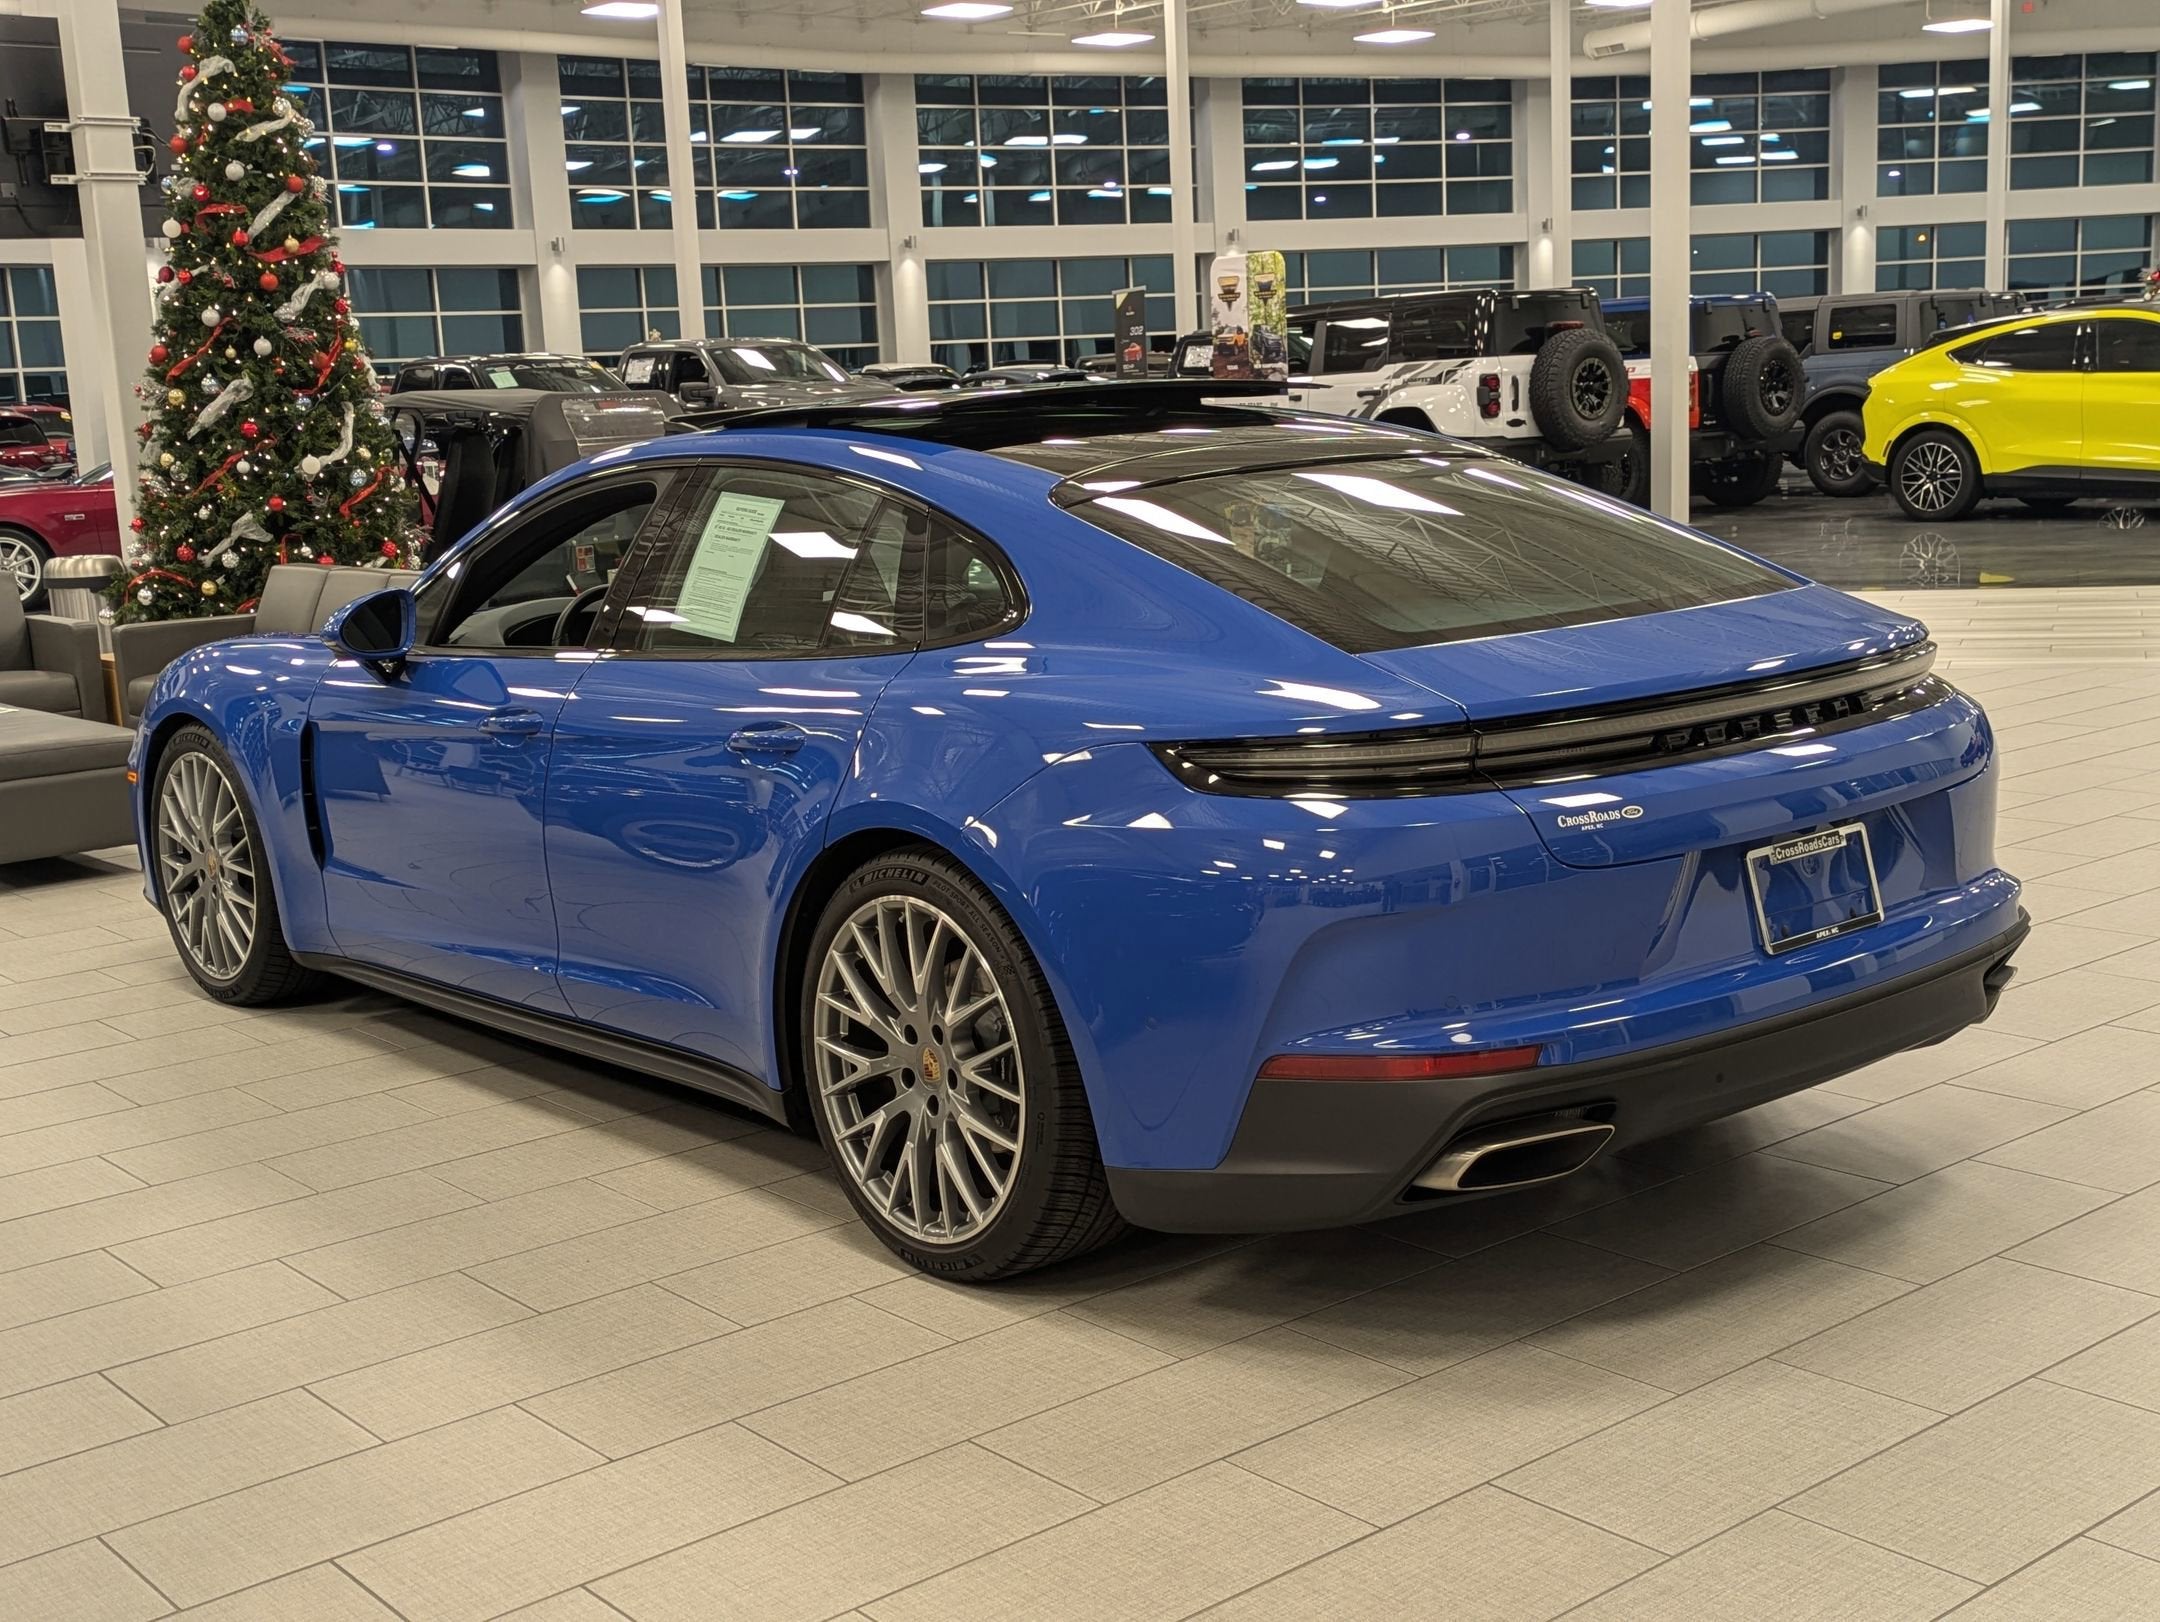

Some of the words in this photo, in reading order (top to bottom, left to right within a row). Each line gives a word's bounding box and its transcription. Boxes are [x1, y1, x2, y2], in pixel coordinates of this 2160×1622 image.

[1129, 325, 1144, 336] 302
[1775, 834, 1840, 860] CrossRoadsCars
[862, 868, 927, 885] MICHELIN
[949, 890, 970, 908] SPORT
[968, 907, 980, 924] ALL
[980, 923, 1001, 953] SEASON
